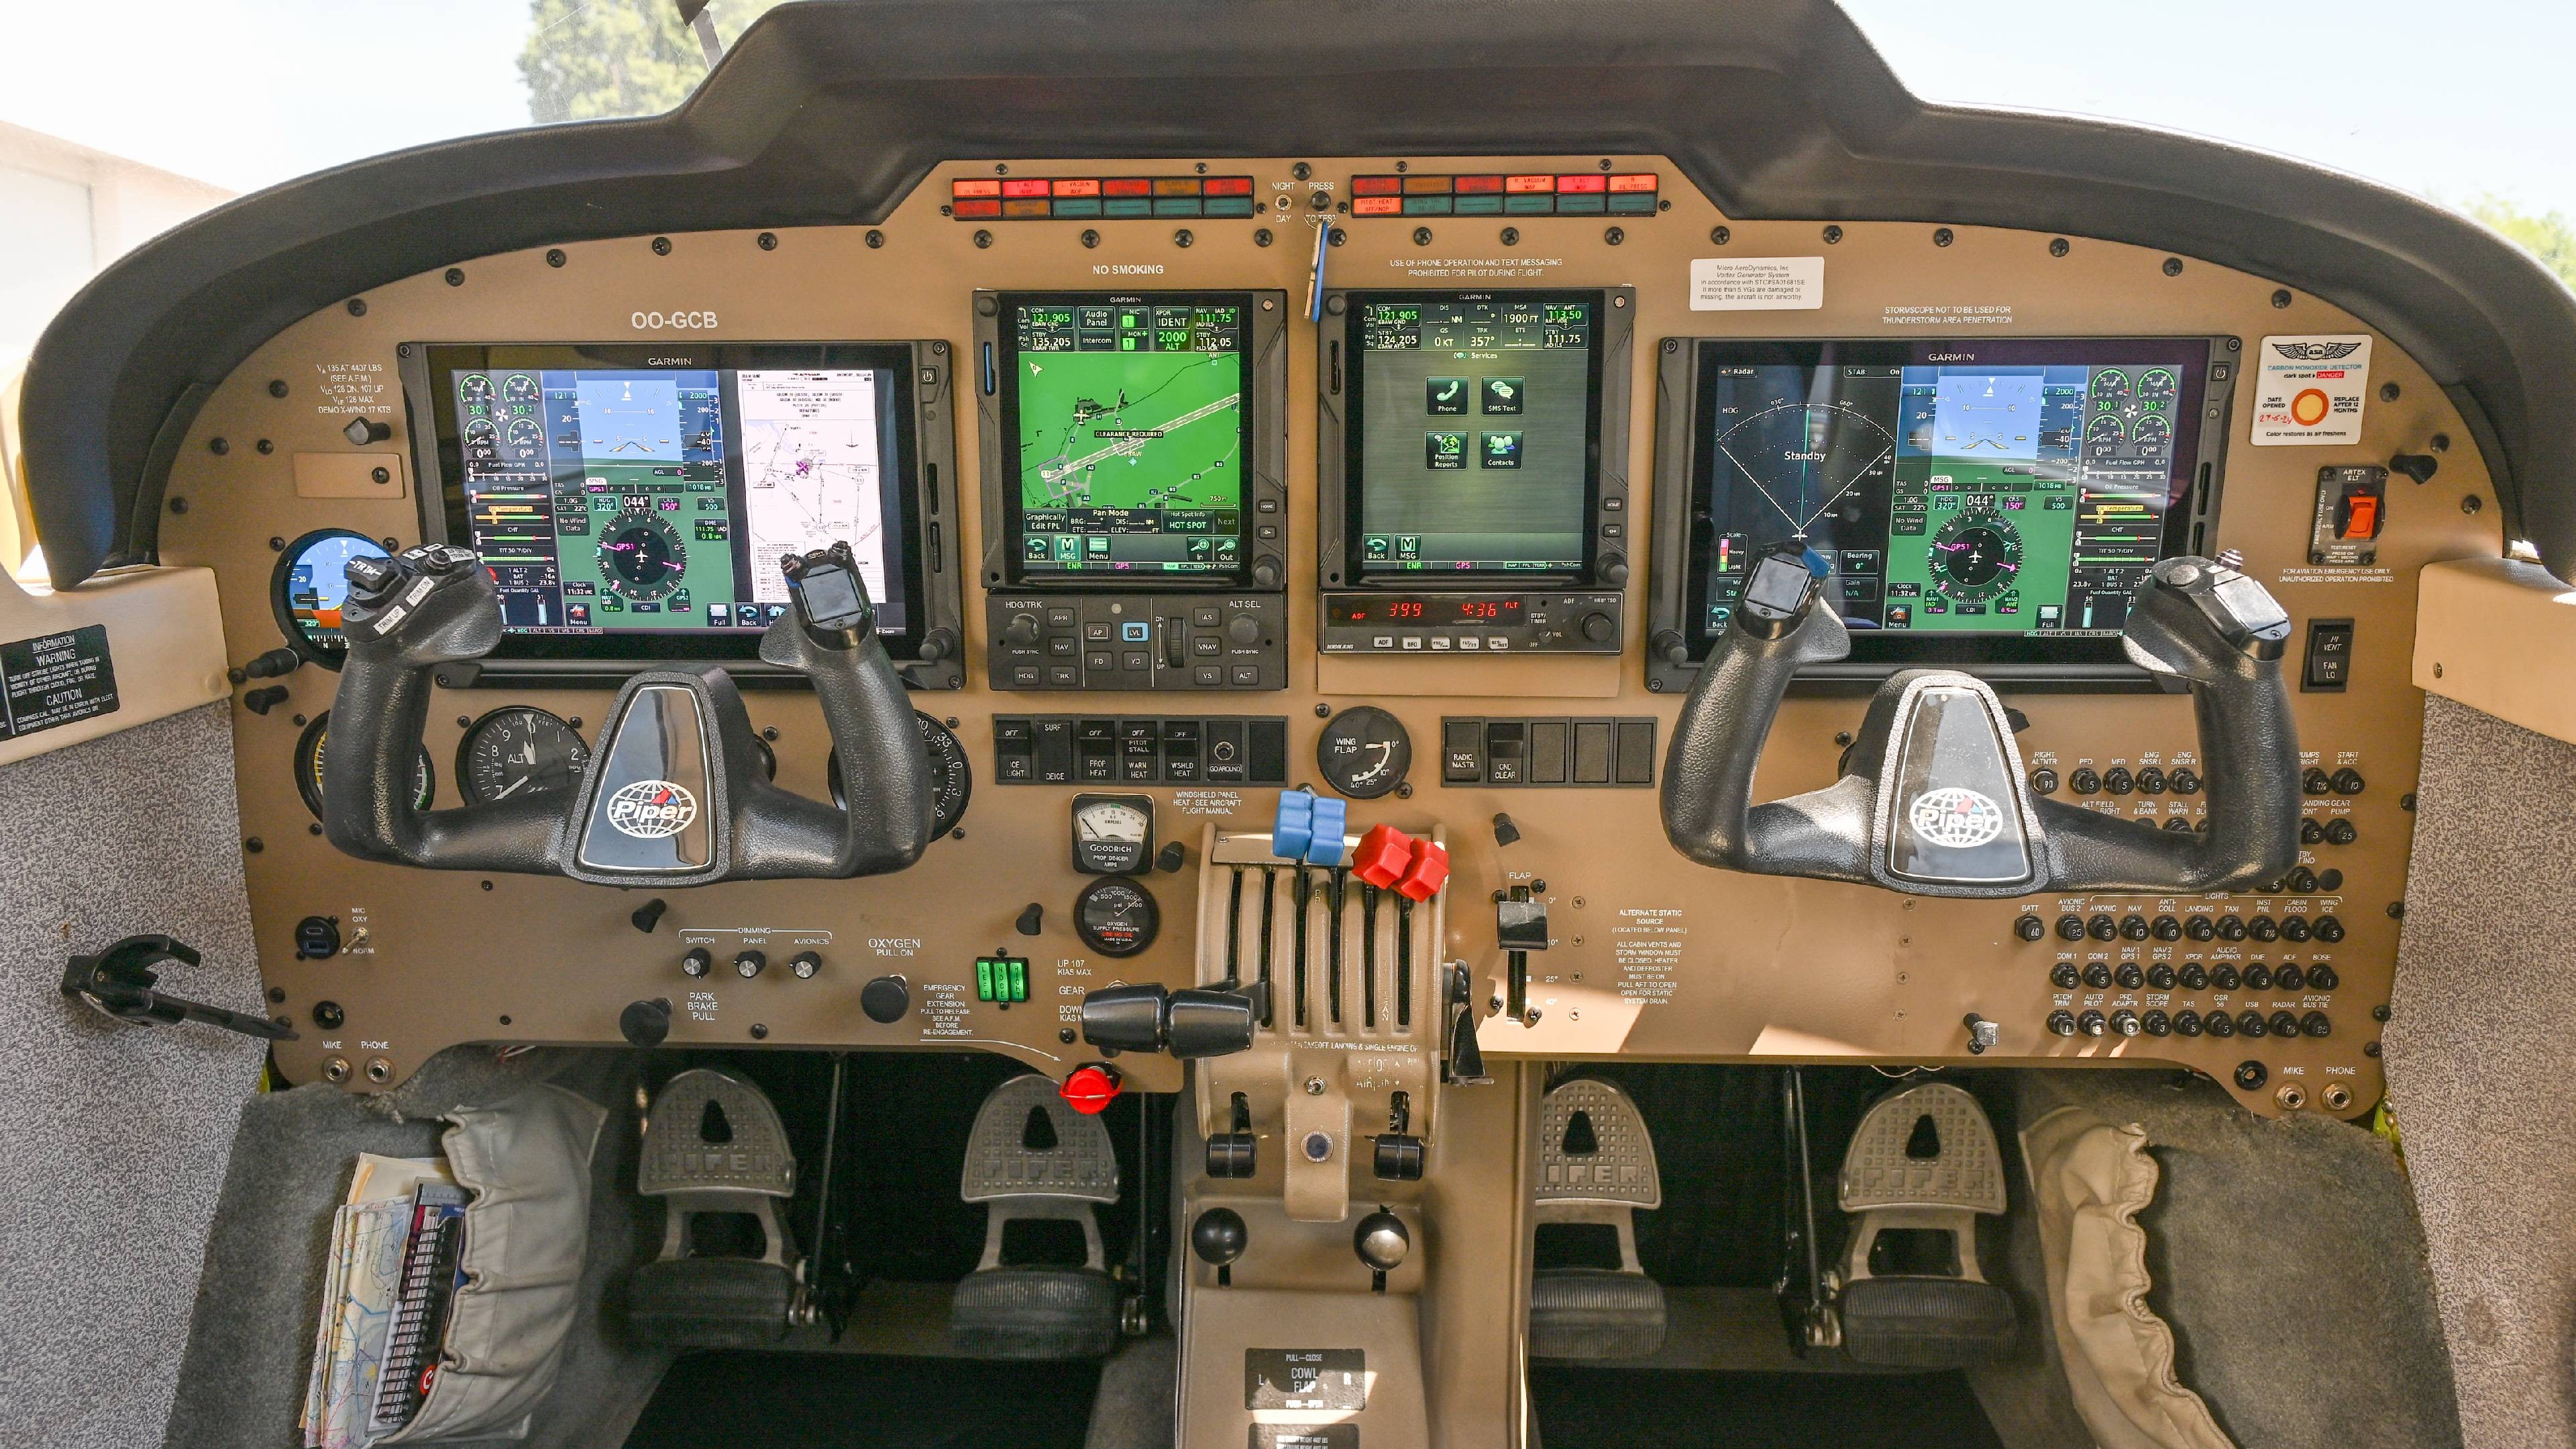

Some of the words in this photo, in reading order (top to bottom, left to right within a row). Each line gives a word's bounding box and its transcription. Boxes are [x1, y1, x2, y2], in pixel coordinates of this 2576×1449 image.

[1093, 265, 1108, 274] NO
[1112, 264, 1164, 274] SMOKING
[1032, 314, 1070, 322] 121.905
[1085, 310, 1108, 318] Audio
[1503, 314, 1528, 323] 1900
[631, 312, 718, 329] OO-GCB
[1087, 319, 1107, 327] Panel
[1159, 318, 1187, 327] IDENT
[1159, 332, 1186, 342] 2000
[1032, 337, 1070, 347] 135.205
[1784, 451, 1826, 462] Standby
[1026, 514, 1065, 523] Graphically
[1390, 603, 1421, 616] 399
[1462, 603, 1496, 616] 4:36
[32, 635, 75, 651] INFORMATION
[36, 649, 75, 667] WARNING
[47, 688, 82, 706] CAUTION
[1335, 738, 1356, 746] WING
[1334, 746, 1357, 754] FLAP
[1006, 769, 1024, 777] LIGHT
[1046, 772, 1065, 780] DEICE
[1495, 771, 1515, 780] CLEAR
[613, 801, 692, 823] Piper
[1917, 809, 1998, 834] Piper
[1090, 844, 1132, 853] GOODRICH
[868, 938, 920, 949] OXYGEN
[690, 993, 714, 1001] PARK
[688, 1002, 718, 1010] BRAKE
[692, 1012, 715, 1020] PULL
[361, 1041, 389, 1049] PHONE
[2284, 1067, 2305, 1075] MIKE
[1291, 1368, 1318, 1379] COWL
